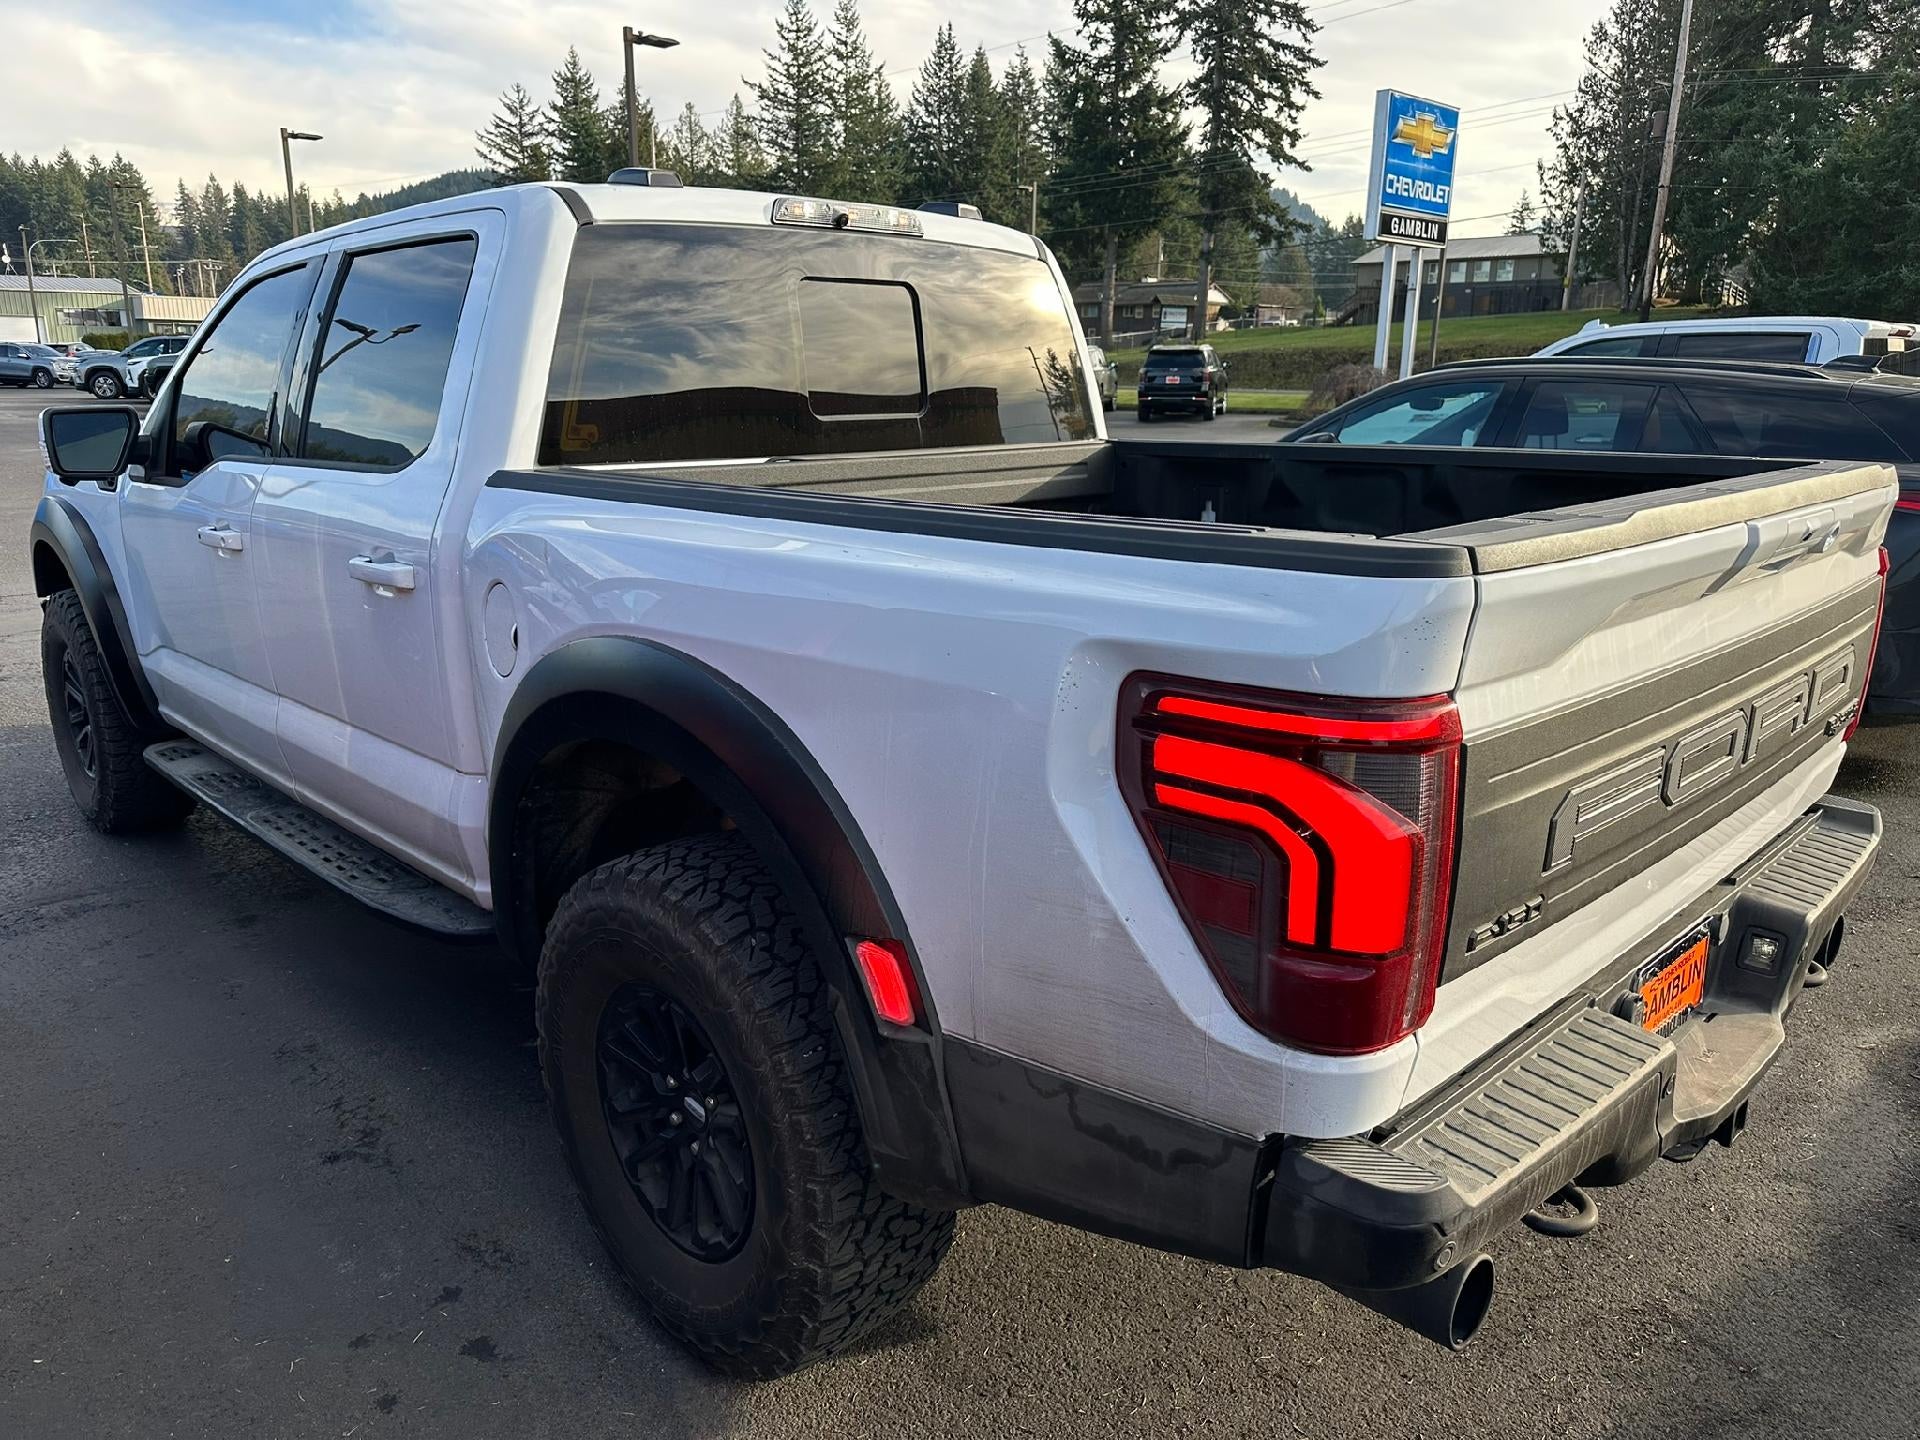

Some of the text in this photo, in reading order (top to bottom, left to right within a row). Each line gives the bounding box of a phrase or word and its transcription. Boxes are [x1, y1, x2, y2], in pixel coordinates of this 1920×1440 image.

[1386, 174, 1449, 203] CHEVROLET
[1391, 218, 1438, 239] GAMBLIN
[1541, 643, 1857, 877] FORD
